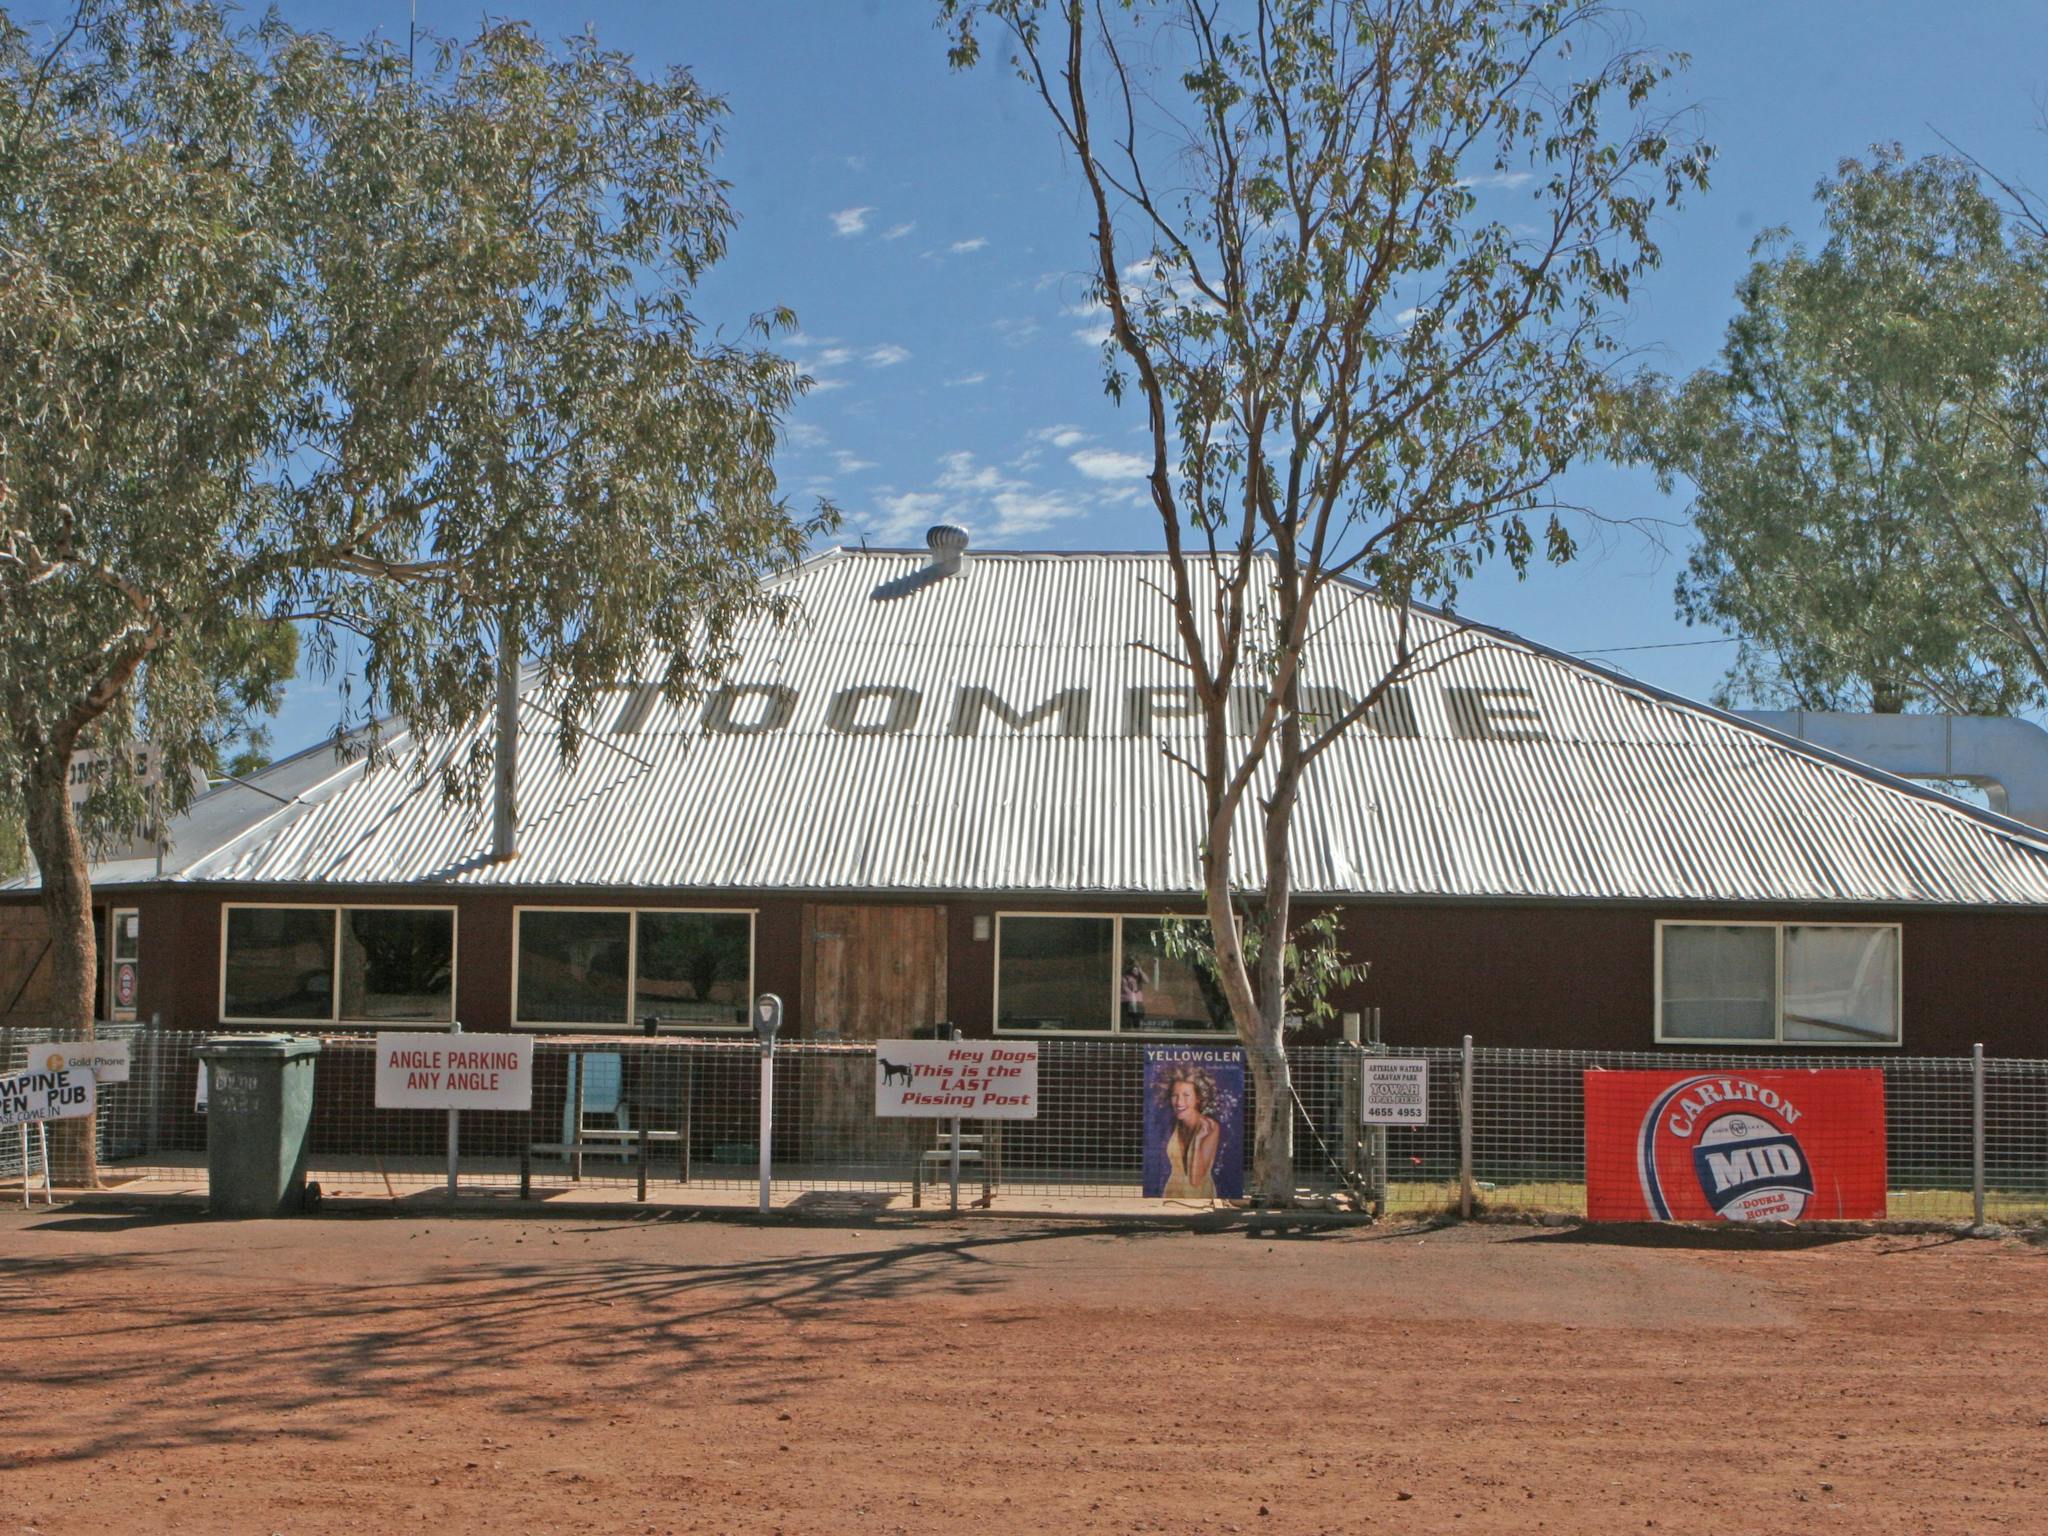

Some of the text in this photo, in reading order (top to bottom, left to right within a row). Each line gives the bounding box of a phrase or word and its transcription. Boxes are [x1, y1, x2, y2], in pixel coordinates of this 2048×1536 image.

[68, 1057, 125, 1067] Gold Phone
[389, 1051, 518, 1070] ANGLE PARKING
[948, 1049, 1037, 1064] Hey Dogs
[1147, 1050, 1241, 1062] YELLOWGLEN
[913, 1064, 1022, 1077] This is the
[1368, 1065, 1423, 1073] ARTESIAN WATERS
[407, 1072, 499, 1091] ANY ANGLE
[1373, 1073, 1418, 1081] CARAVAN PARK
[940, 1079, 992, 1091] LAST
[1369, 1083, 1420, 1096] YOWAH
[0, 1095, 28, 1115] EN
[901, 1093, 1031, 1108] Pissing Post
[17, 1108, 45, 1121] COME
[48, 1105, 60, 1117] IN
[1368, 1107, 1422, 1117] 4655 4953
[1669, 1079, 1803, 1138] CARLTON
[1705, 1143, 1801, 1194] MID
[1743, 1193, 1786, 1210] DOUBLE
[1745, 1203, 1790, 1220] HOPPED
